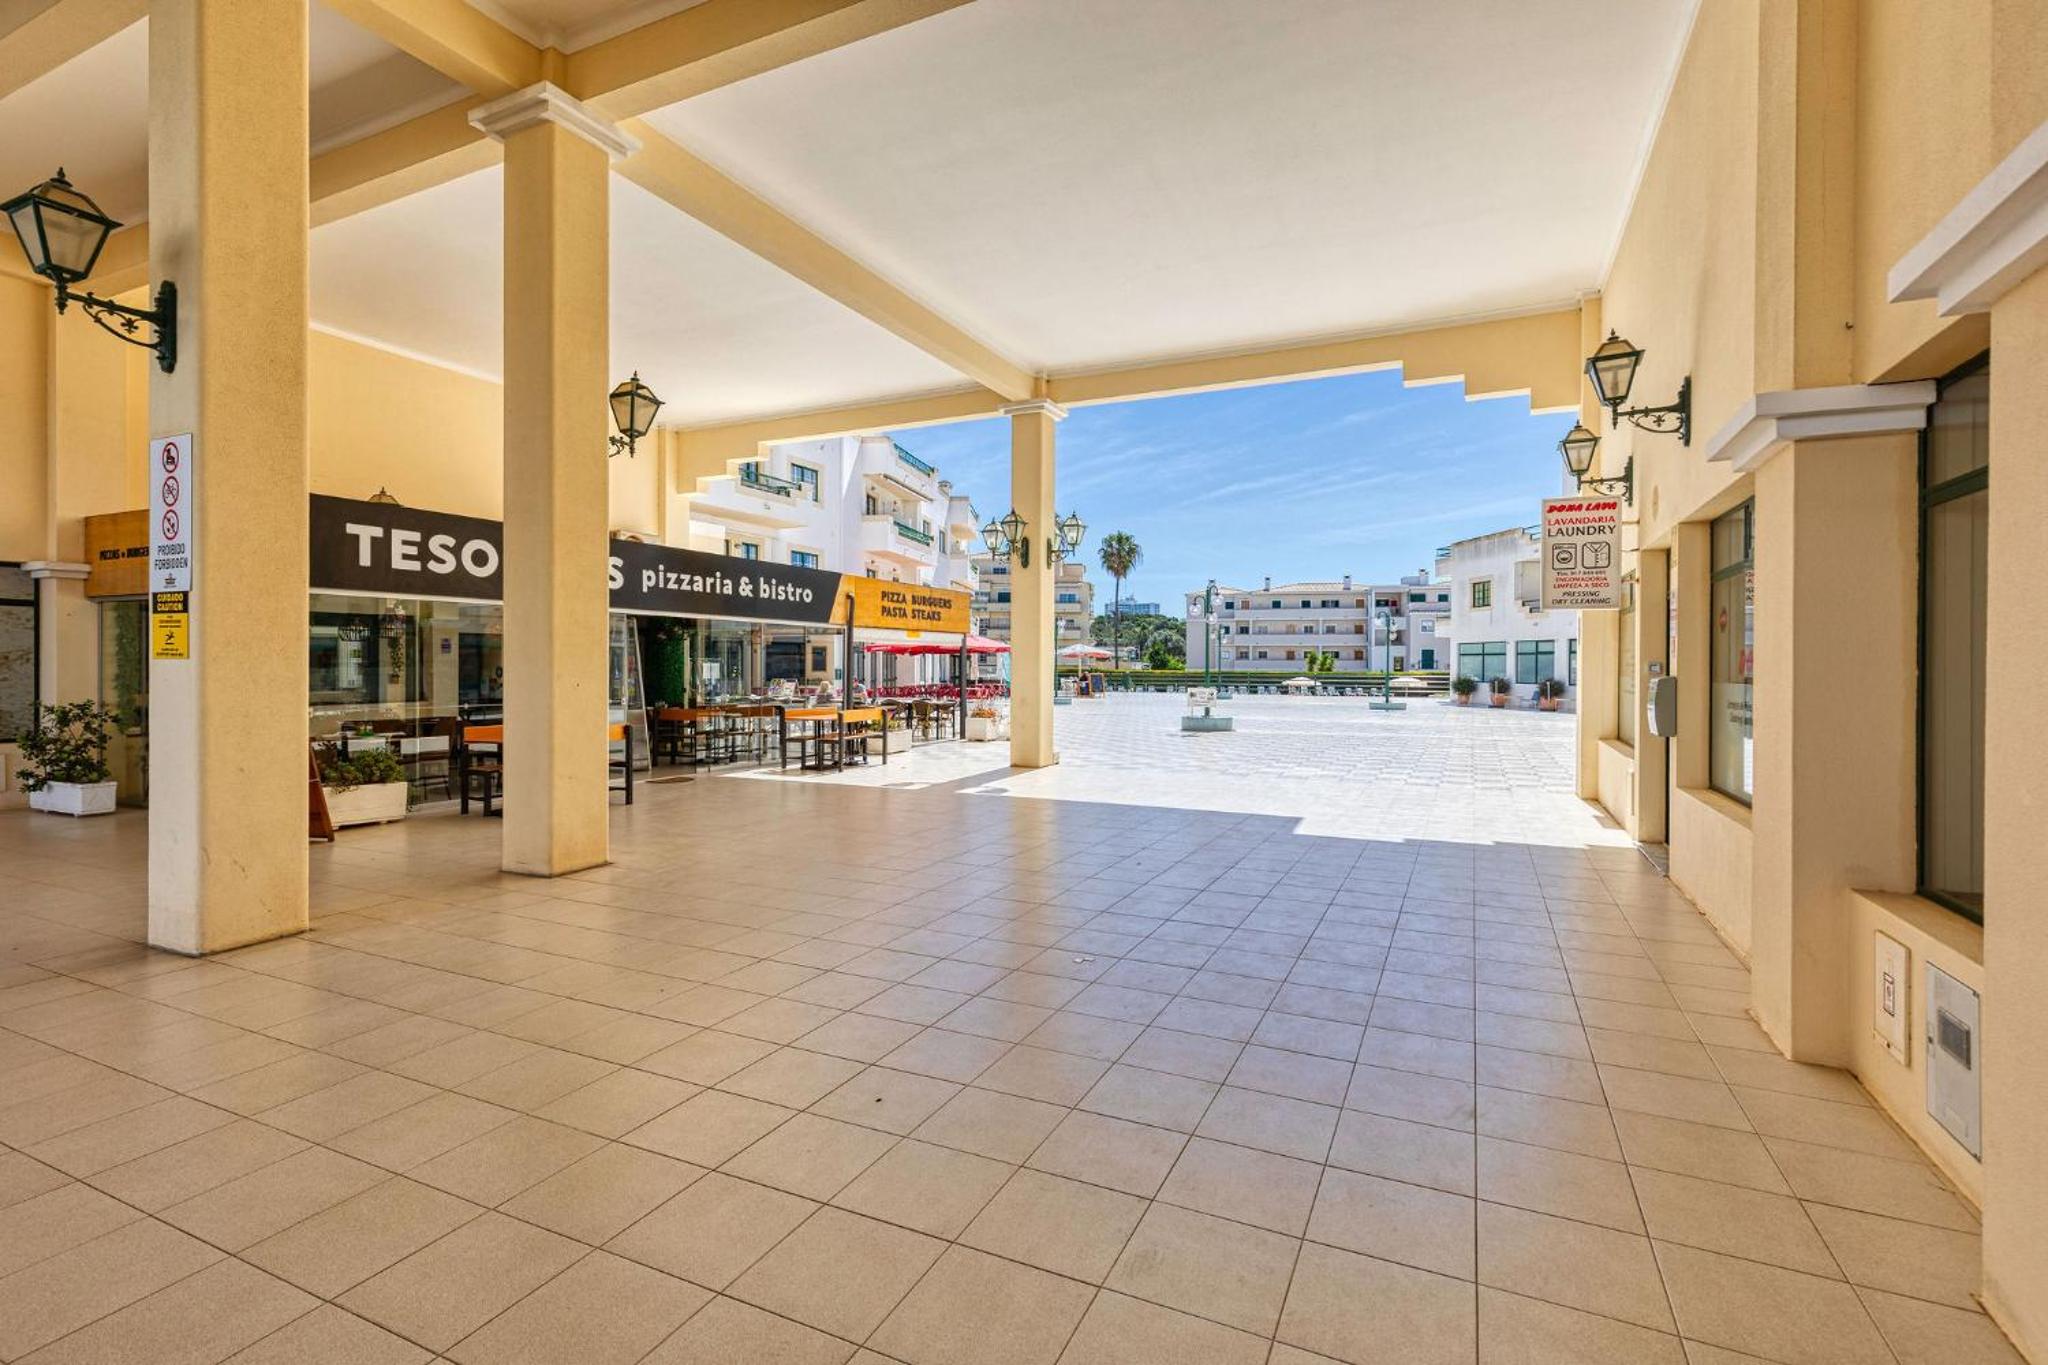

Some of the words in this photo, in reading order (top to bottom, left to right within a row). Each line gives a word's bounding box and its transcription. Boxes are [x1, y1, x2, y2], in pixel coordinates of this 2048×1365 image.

[1547, 515, 1616, 526] LAVANDARIA
[1547, 525, 1616, 537] LAUNDRY
[157, 543, 185, 556] PROIBIDO
[154, 557, 188, 570] FORBIDDEN
[642, 564, 733, 595] pizzaria
[738, 576, 754, 597] &
[759, 576, 813, 603] bistro
[881, 590, 907, 605] PIZZA
[911, 594, 952, 609] BURGUERS
[1570, 597, 1611, 605] CLEANING
[881, 606, 908, 618] PASTA
[911, 608, 942, 622] STEAKS
